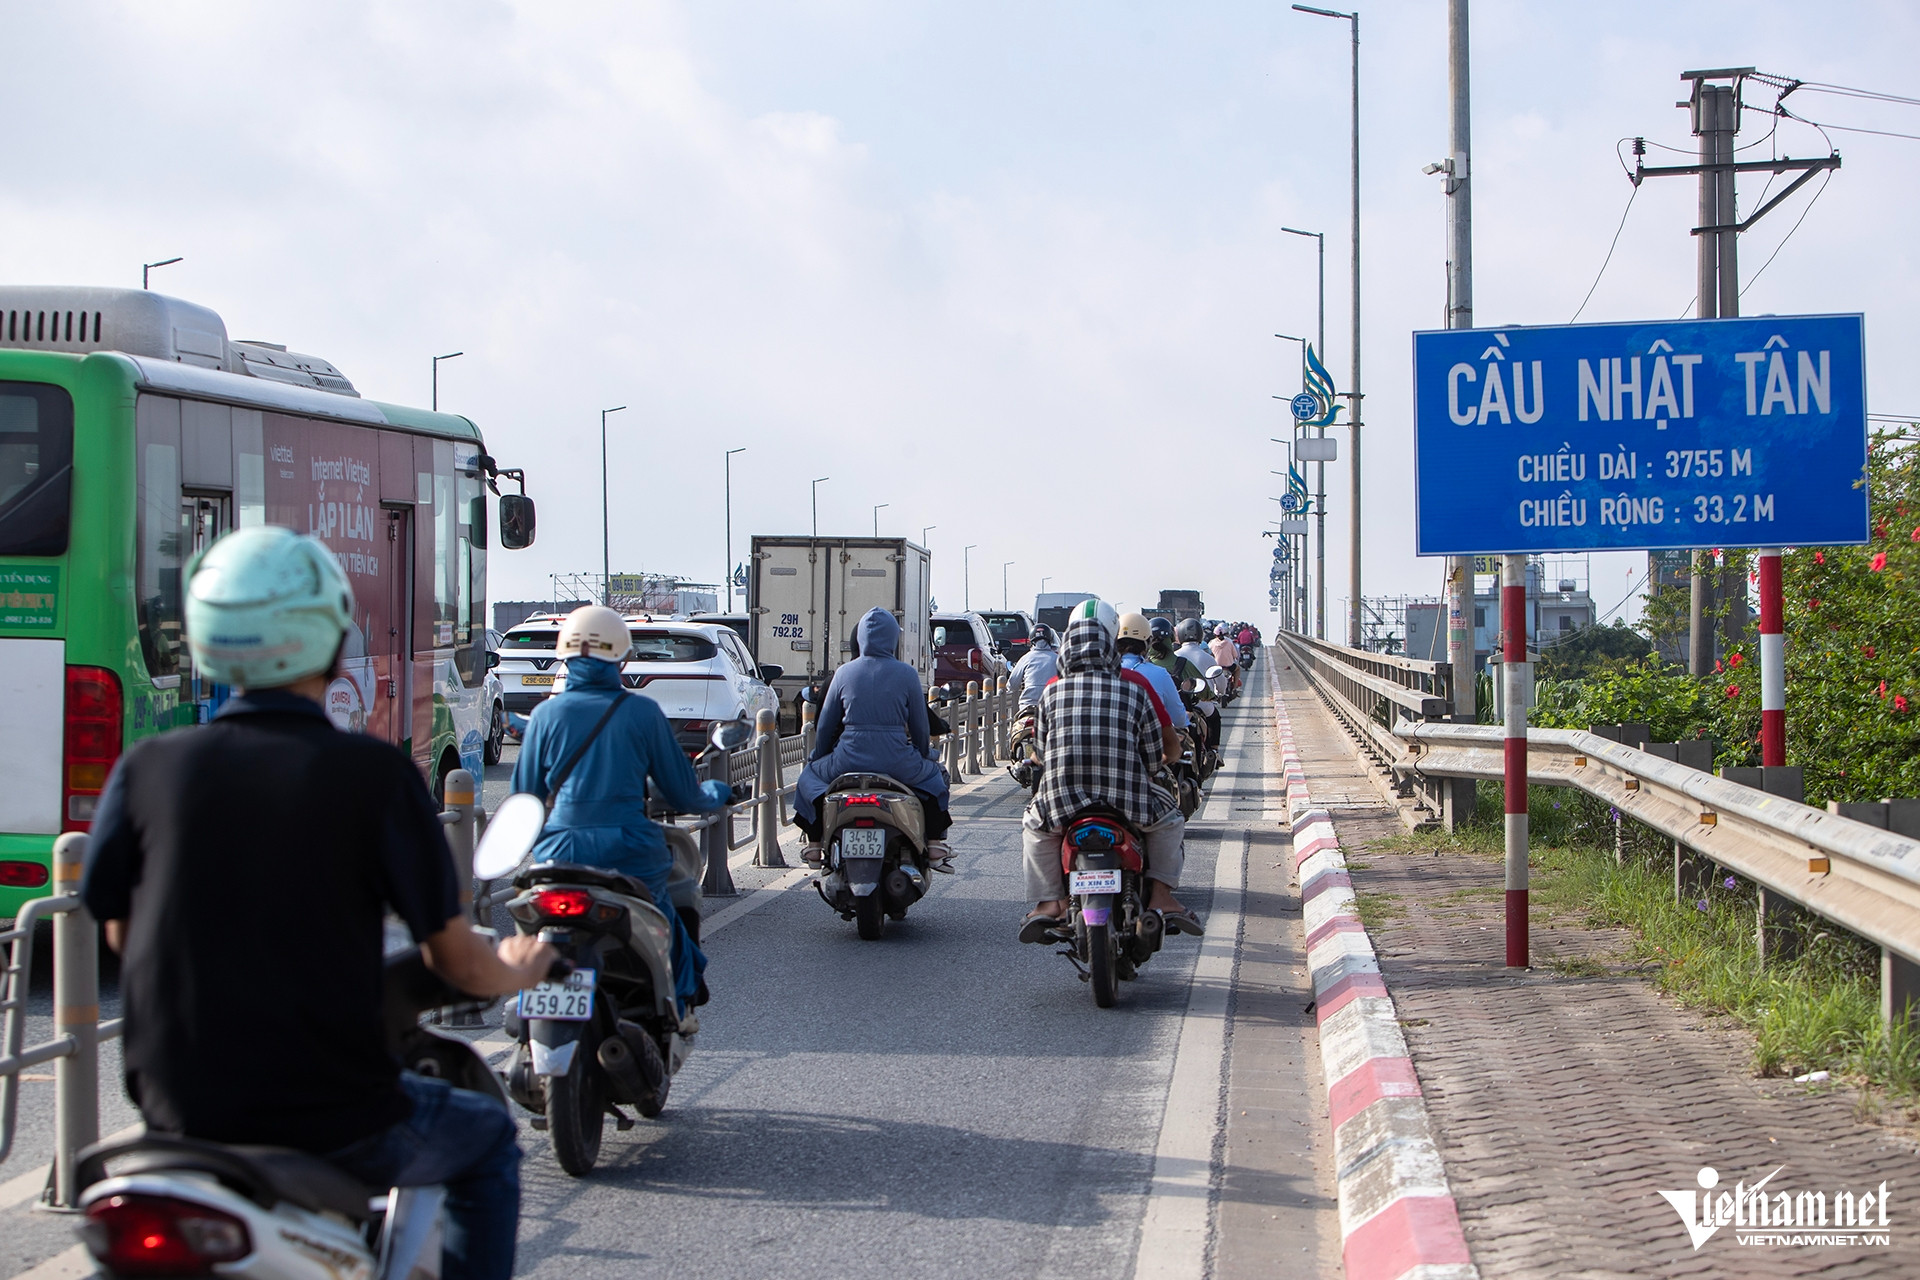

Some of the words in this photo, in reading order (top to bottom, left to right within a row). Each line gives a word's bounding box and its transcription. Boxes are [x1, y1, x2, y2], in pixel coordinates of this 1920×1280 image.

[1447, 333, 1544, 426] CẦU
[1578, 338, 1703, 430] NHẬT
[1735, 334, 1831, 415] TÂN
[311, 456, 343, 481] Internet
[344, 456, 371, 487] Viettel
[1518, 441, 1585, 482] CHIỀU
[1599, 443, 1637, 480] DÀI
[1665, 450, 1723, 478] 3755
[1731, 449, 1752, 476] M
[309, 480, 337, 538] LẮP
[347, 484, 374, 542] LẦN
[1519, 489, 1587, 527] CHIỀU
[1600, 492, 1664, 532] RỘNG
[1694, 496, 1748, 526] 33,2
[1753, 494, 1775, 522] M
[781, 614, 799, 625] 29H
[772, 627, 804, 638] 792.82
[332, 691, 350, 705] CAMERA
[850, 831, 878, 842] 34-B4
[844, 844, 882, 855] 458.52
[524, 995, 587, 1015] 459.26
